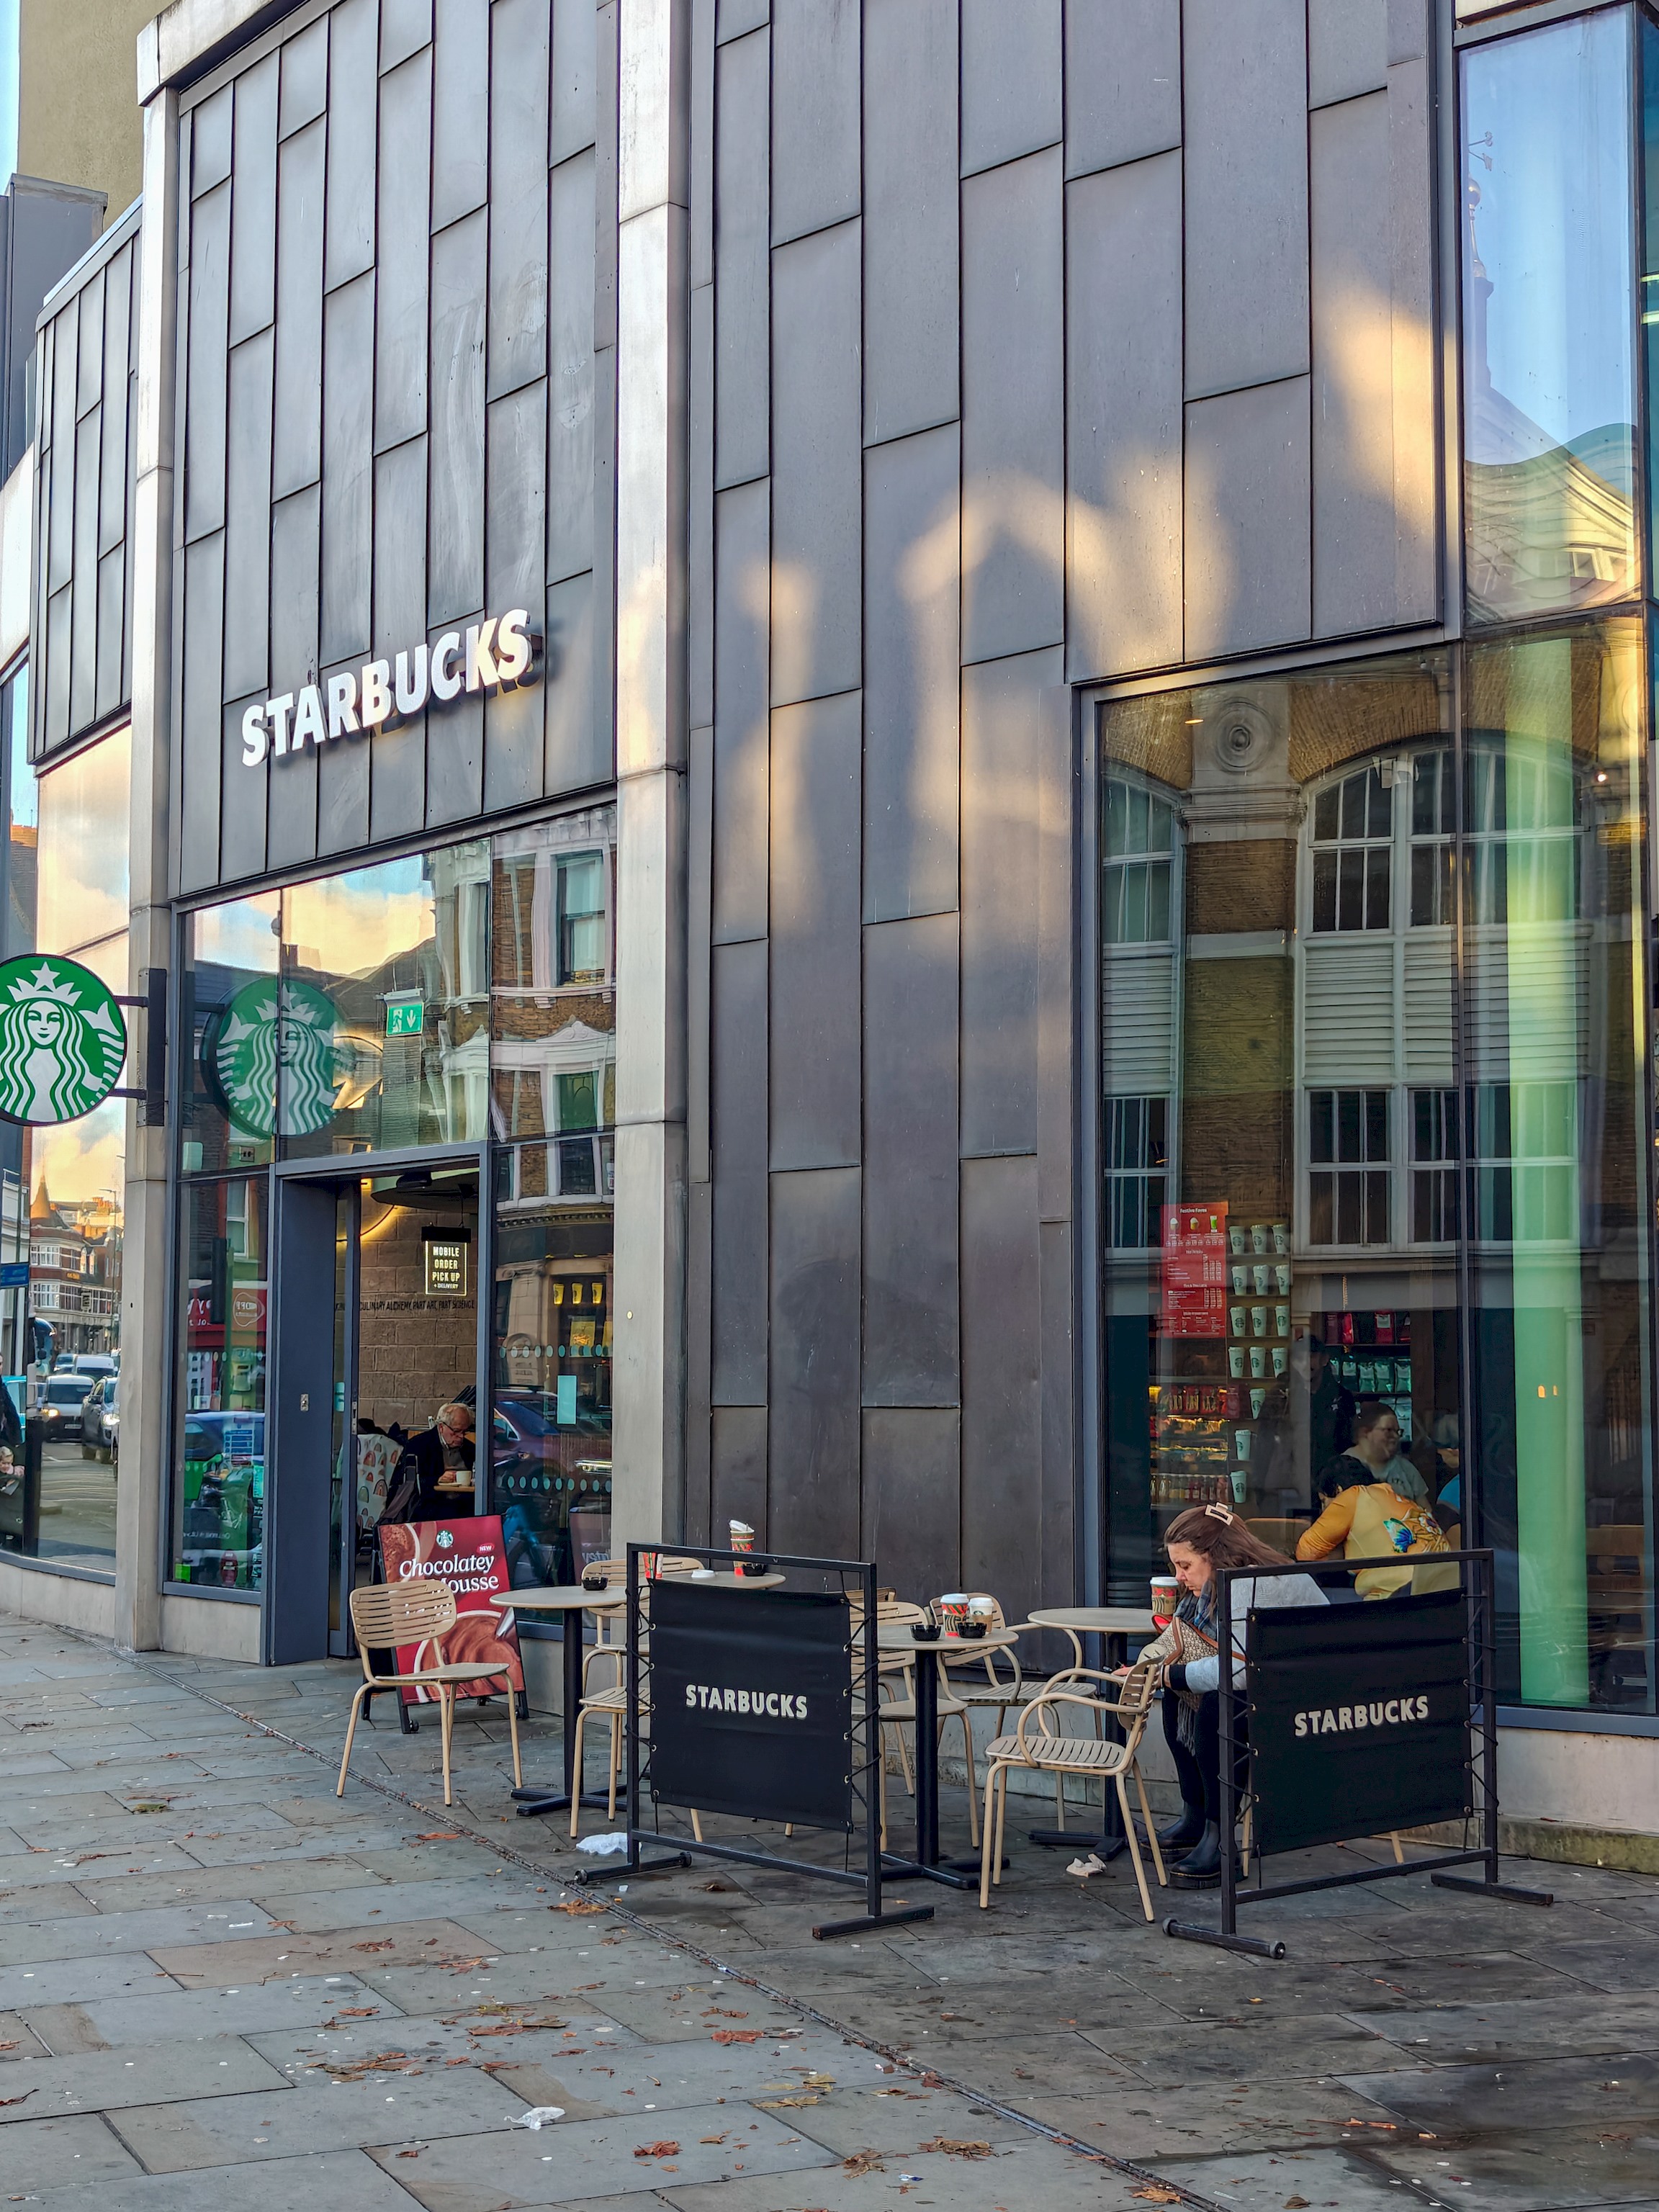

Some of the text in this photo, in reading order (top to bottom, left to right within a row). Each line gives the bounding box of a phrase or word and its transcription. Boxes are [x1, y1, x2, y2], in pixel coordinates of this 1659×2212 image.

[241, 608, 534, 768] STARBUCKS
[433, 1246, 460, 1257] MOBILE
[434, 1259, 458, 1269] ORDER
[432, 1272, 460, 1282] PICK UP
[399, 1553, 495, 1578] Chocolatey
[685, 1683, 808, 1719] STARBUCKS
[1294, 1696, 1429, 1737] STARBUCKS
